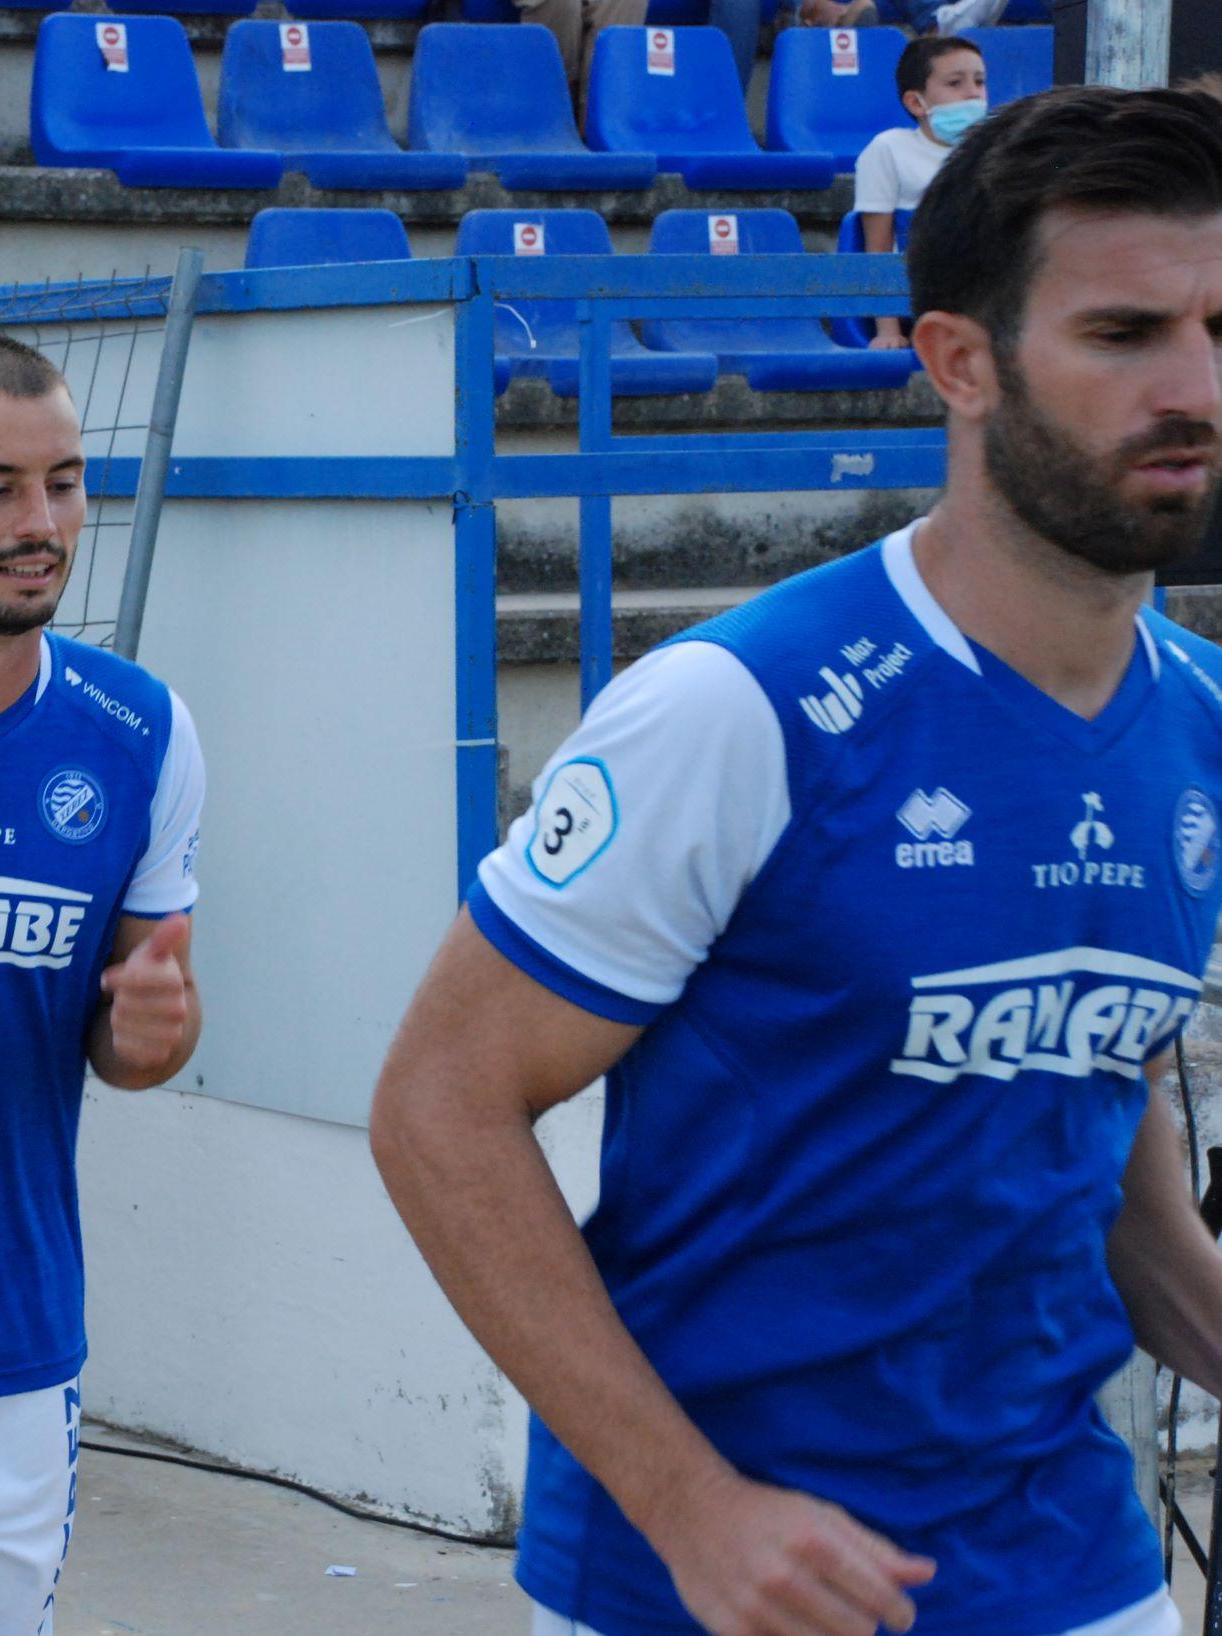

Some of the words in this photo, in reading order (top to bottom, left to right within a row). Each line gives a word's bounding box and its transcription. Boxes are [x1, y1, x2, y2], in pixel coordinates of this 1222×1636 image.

[840, 636, 878, 667] Max
[861, 641, 914, 691] Project
[82, 681, 143, 731] WINCOM
[544, 807, 574, 856] 3
[894, 838, 975, 869] errea
[1031, 862, 1079, 889] TIO
[1082, 862, 1147, 889] PEPE
